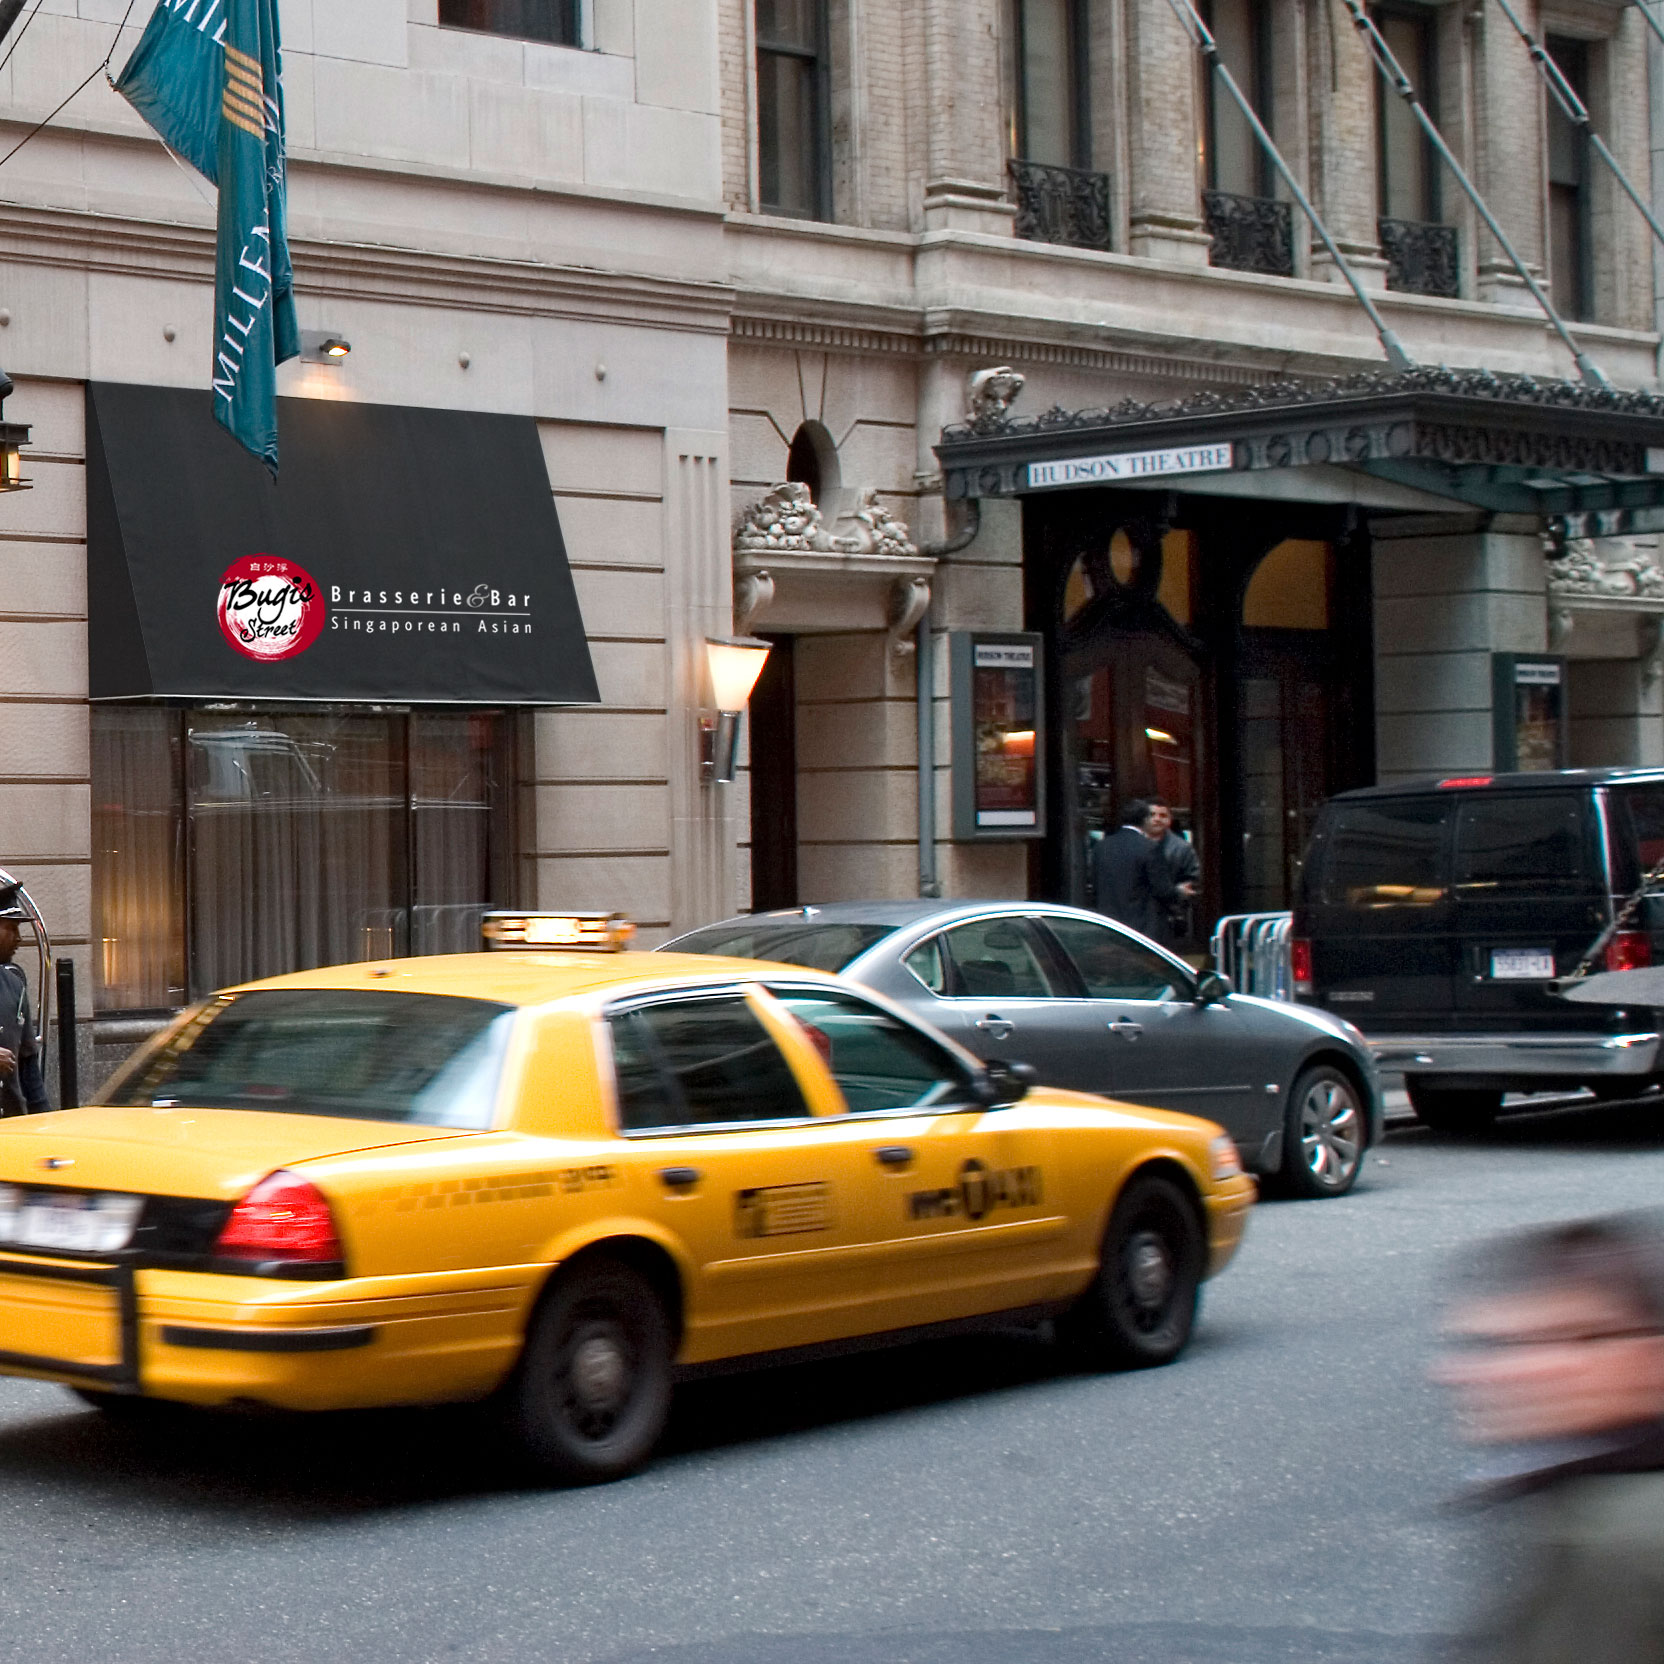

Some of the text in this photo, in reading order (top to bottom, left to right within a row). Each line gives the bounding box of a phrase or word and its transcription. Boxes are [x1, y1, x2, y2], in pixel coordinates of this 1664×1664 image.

[1033, 447, 1228, 483] HUDSON THEATRE
[224, 576, 315, 625] Bugis
[331, 585, 462, 605] Brasserie
[491, 589, 531, 607] Bar
[240, 618, 297, 642] Street
[331, 616, 532, 633] Singaporean Asian
